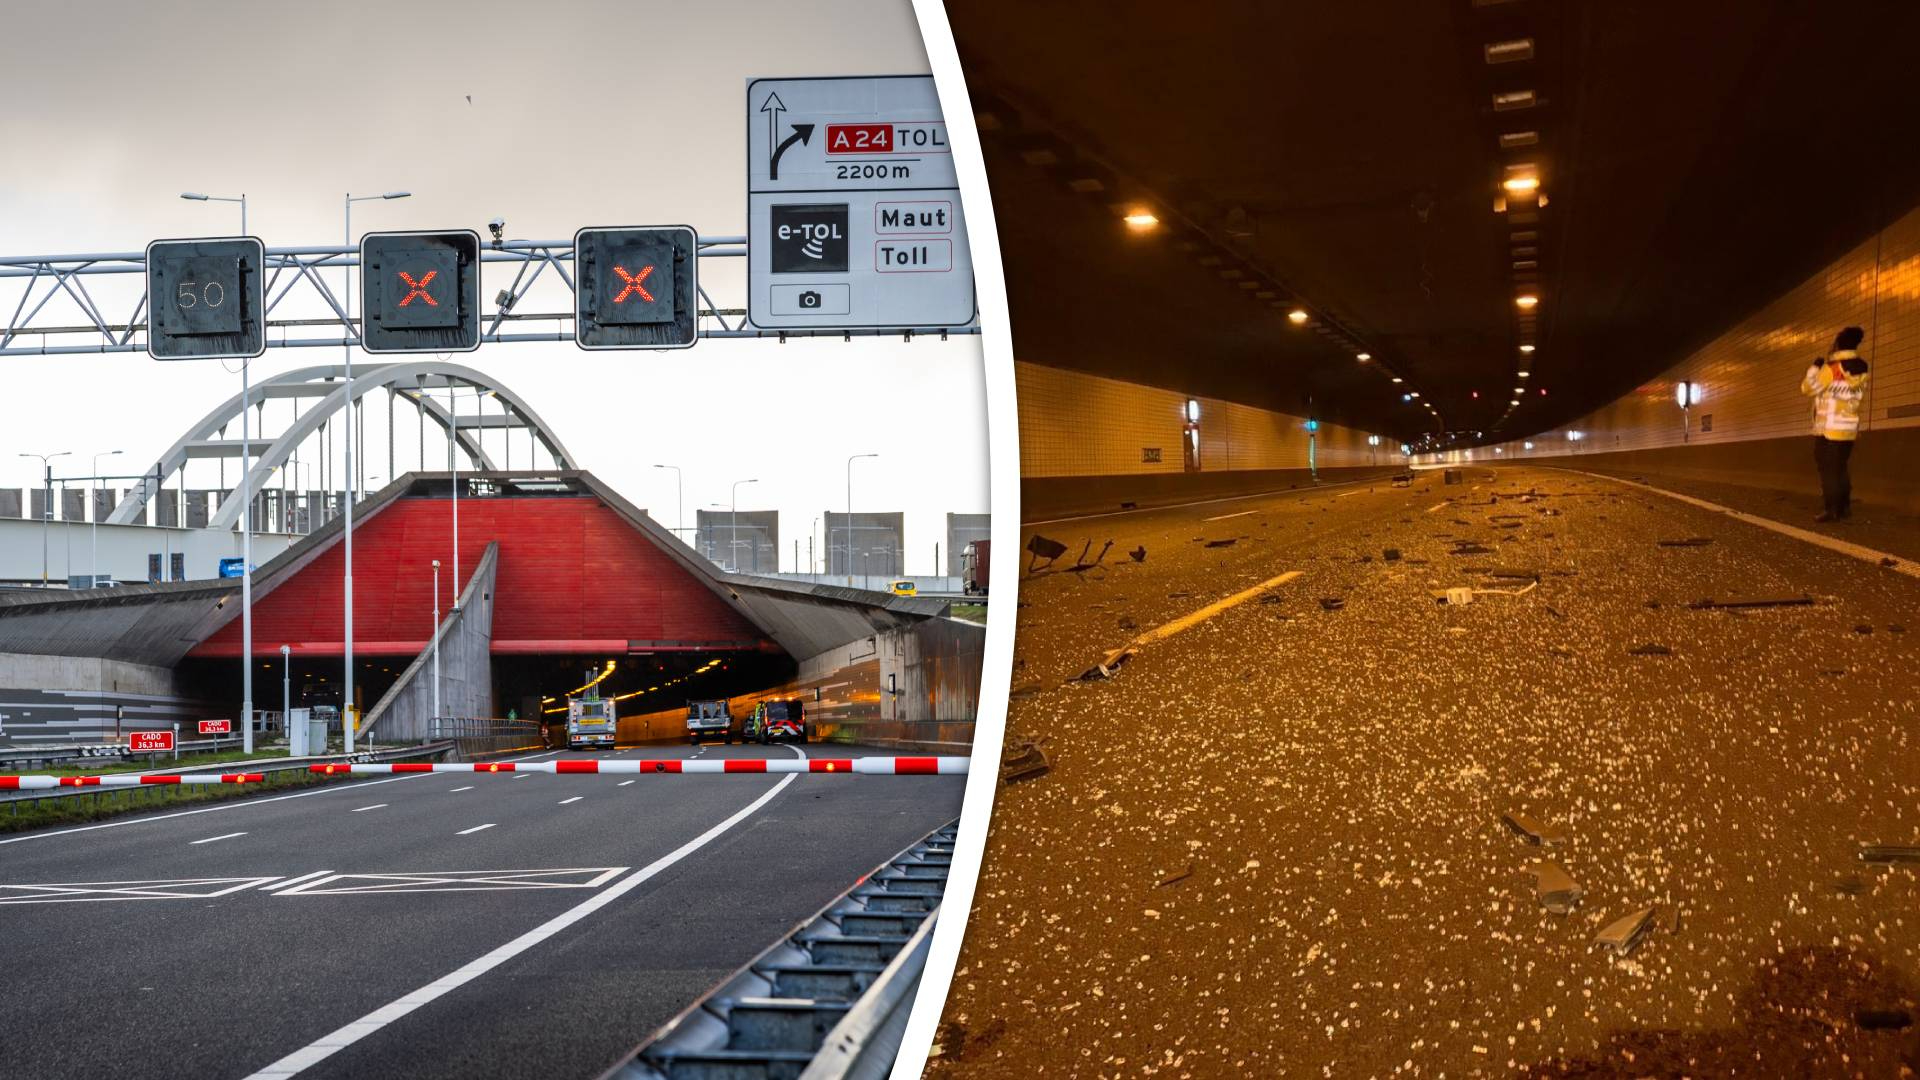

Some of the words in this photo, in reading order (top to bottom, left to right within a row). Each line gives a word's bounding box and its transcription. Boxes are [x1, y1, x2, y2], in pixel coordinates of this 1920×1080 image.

[833, 129, 888, 148] A24
[897, 129, 945, 147] TOL
[882, 208, 946, 228] Maut
[778, 223, 842, 240] e-TOL
[881, 246, 928, 265] Toll
[179, 281, 224, 308] 50
[141, 733, 162, 741] CADO
